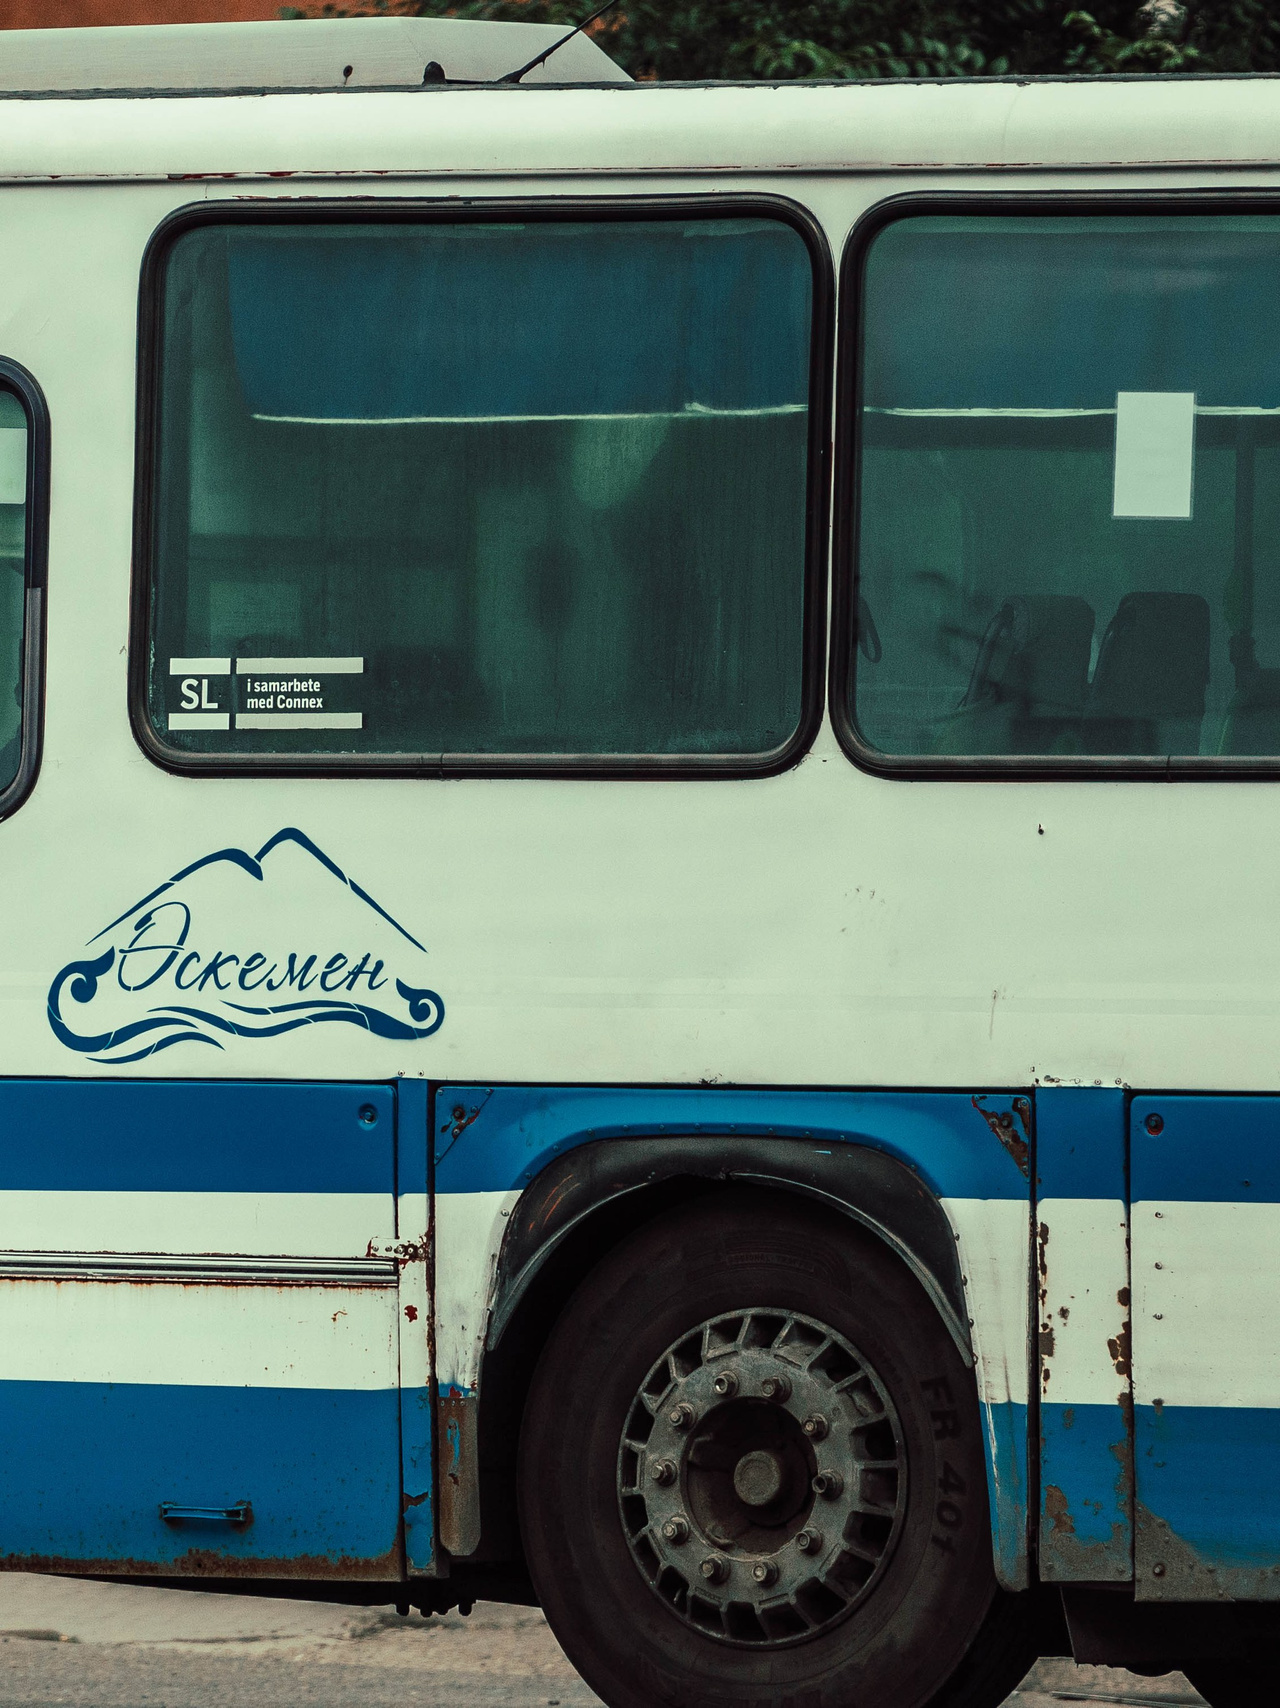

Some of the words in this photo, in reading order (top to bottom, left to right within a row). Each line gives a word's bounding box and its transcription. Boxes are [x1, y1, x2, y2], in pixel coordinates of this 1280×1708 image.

[180, 678, 219, 710] SL
[247, 679, 252, 692] i
[254, 679, 321, 692] samarbete
[247, 695, 274, 709] med
[276, 695, 323, 709] Connex
[920, 1375, 962, 1441] FR
